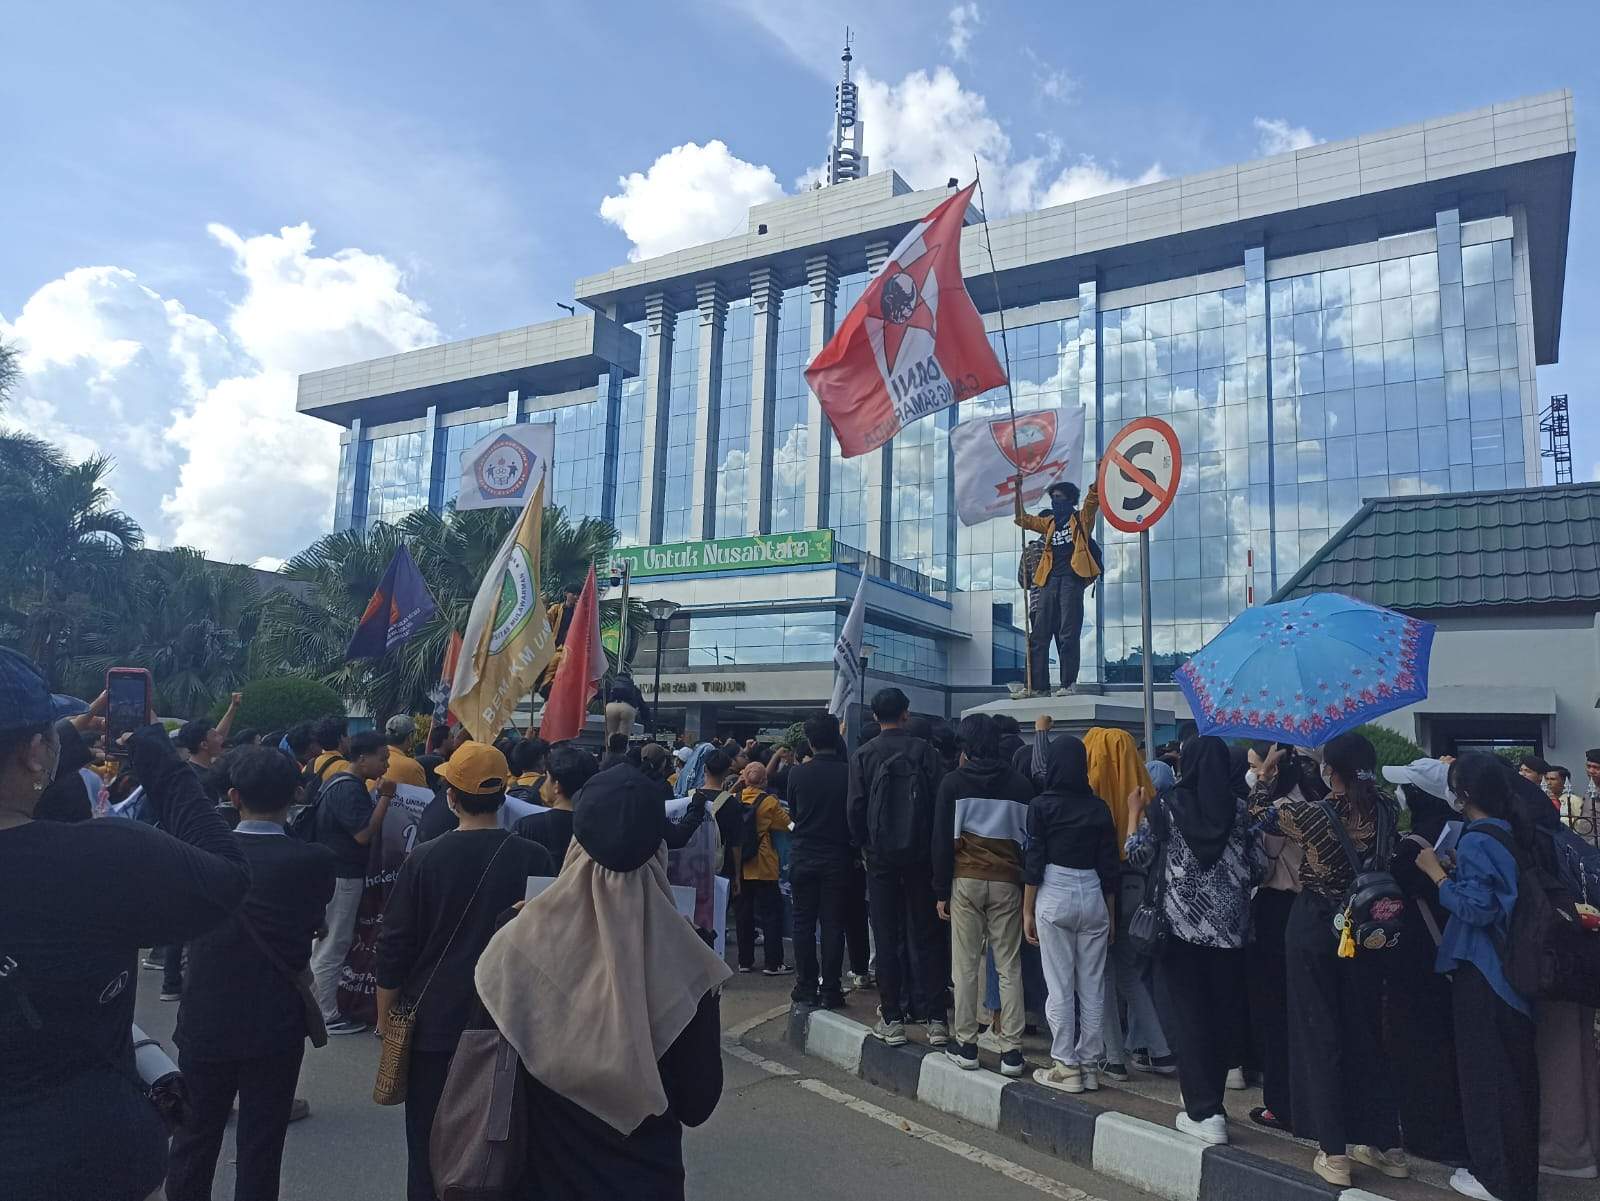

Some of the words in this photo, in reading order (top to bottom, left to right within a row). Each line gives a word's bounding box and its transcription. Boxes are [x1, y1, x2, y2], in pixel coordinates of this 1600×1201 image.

[1119, 440, 1156, 511] S
[643, 545, 698, 570] Untuk
[703, 540, 808, 565] Nusantara
[482, 677, 510, 724] BEM
